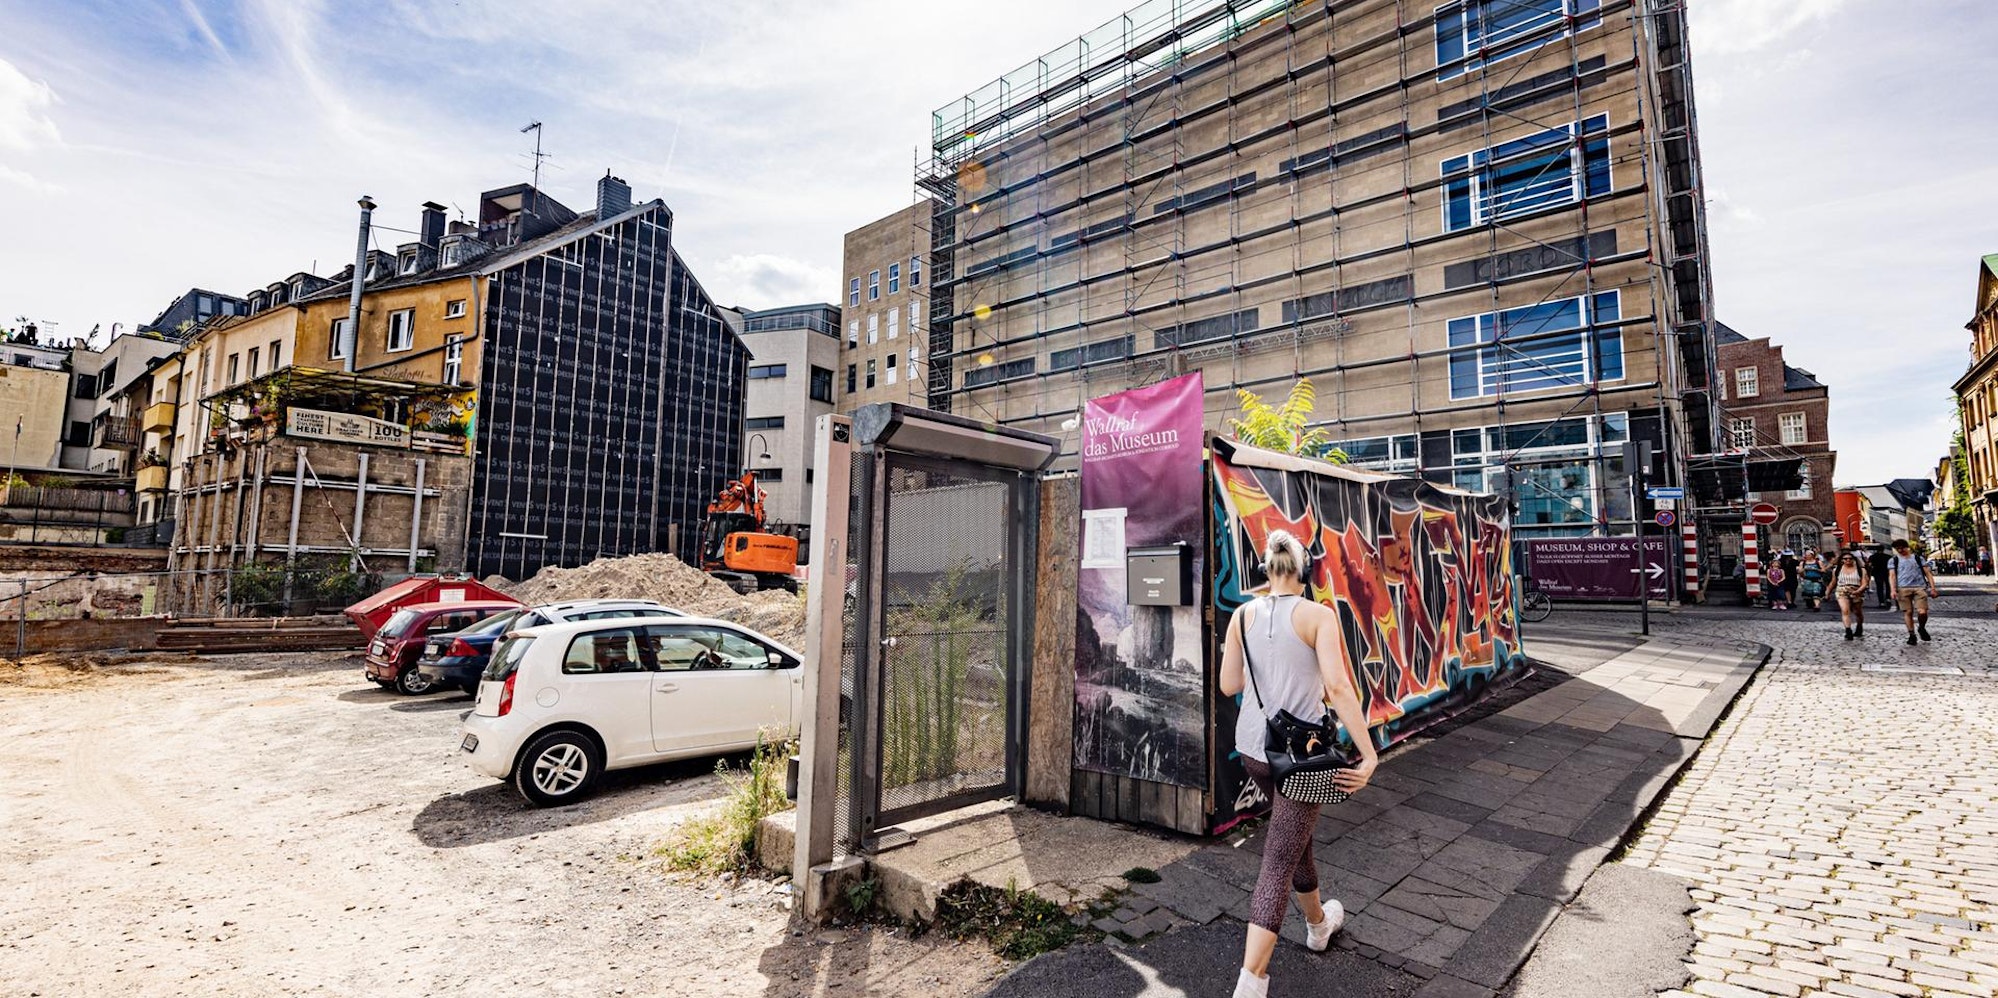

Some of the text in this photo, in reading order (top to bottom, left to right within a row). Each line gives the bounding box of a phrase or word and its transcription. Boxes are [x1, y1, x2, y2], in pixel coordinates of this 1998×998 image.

[296, 426, 324, 435] HERE
[1086, 410, 1139, 437] Wallraf
[1085, 429, 1179, 457] das Museum
[1536, 543, 1585, 552] MUSEUM,
[1587, 543, 1617, 551] SHOP
[1620, 543, 1630, 551] &
